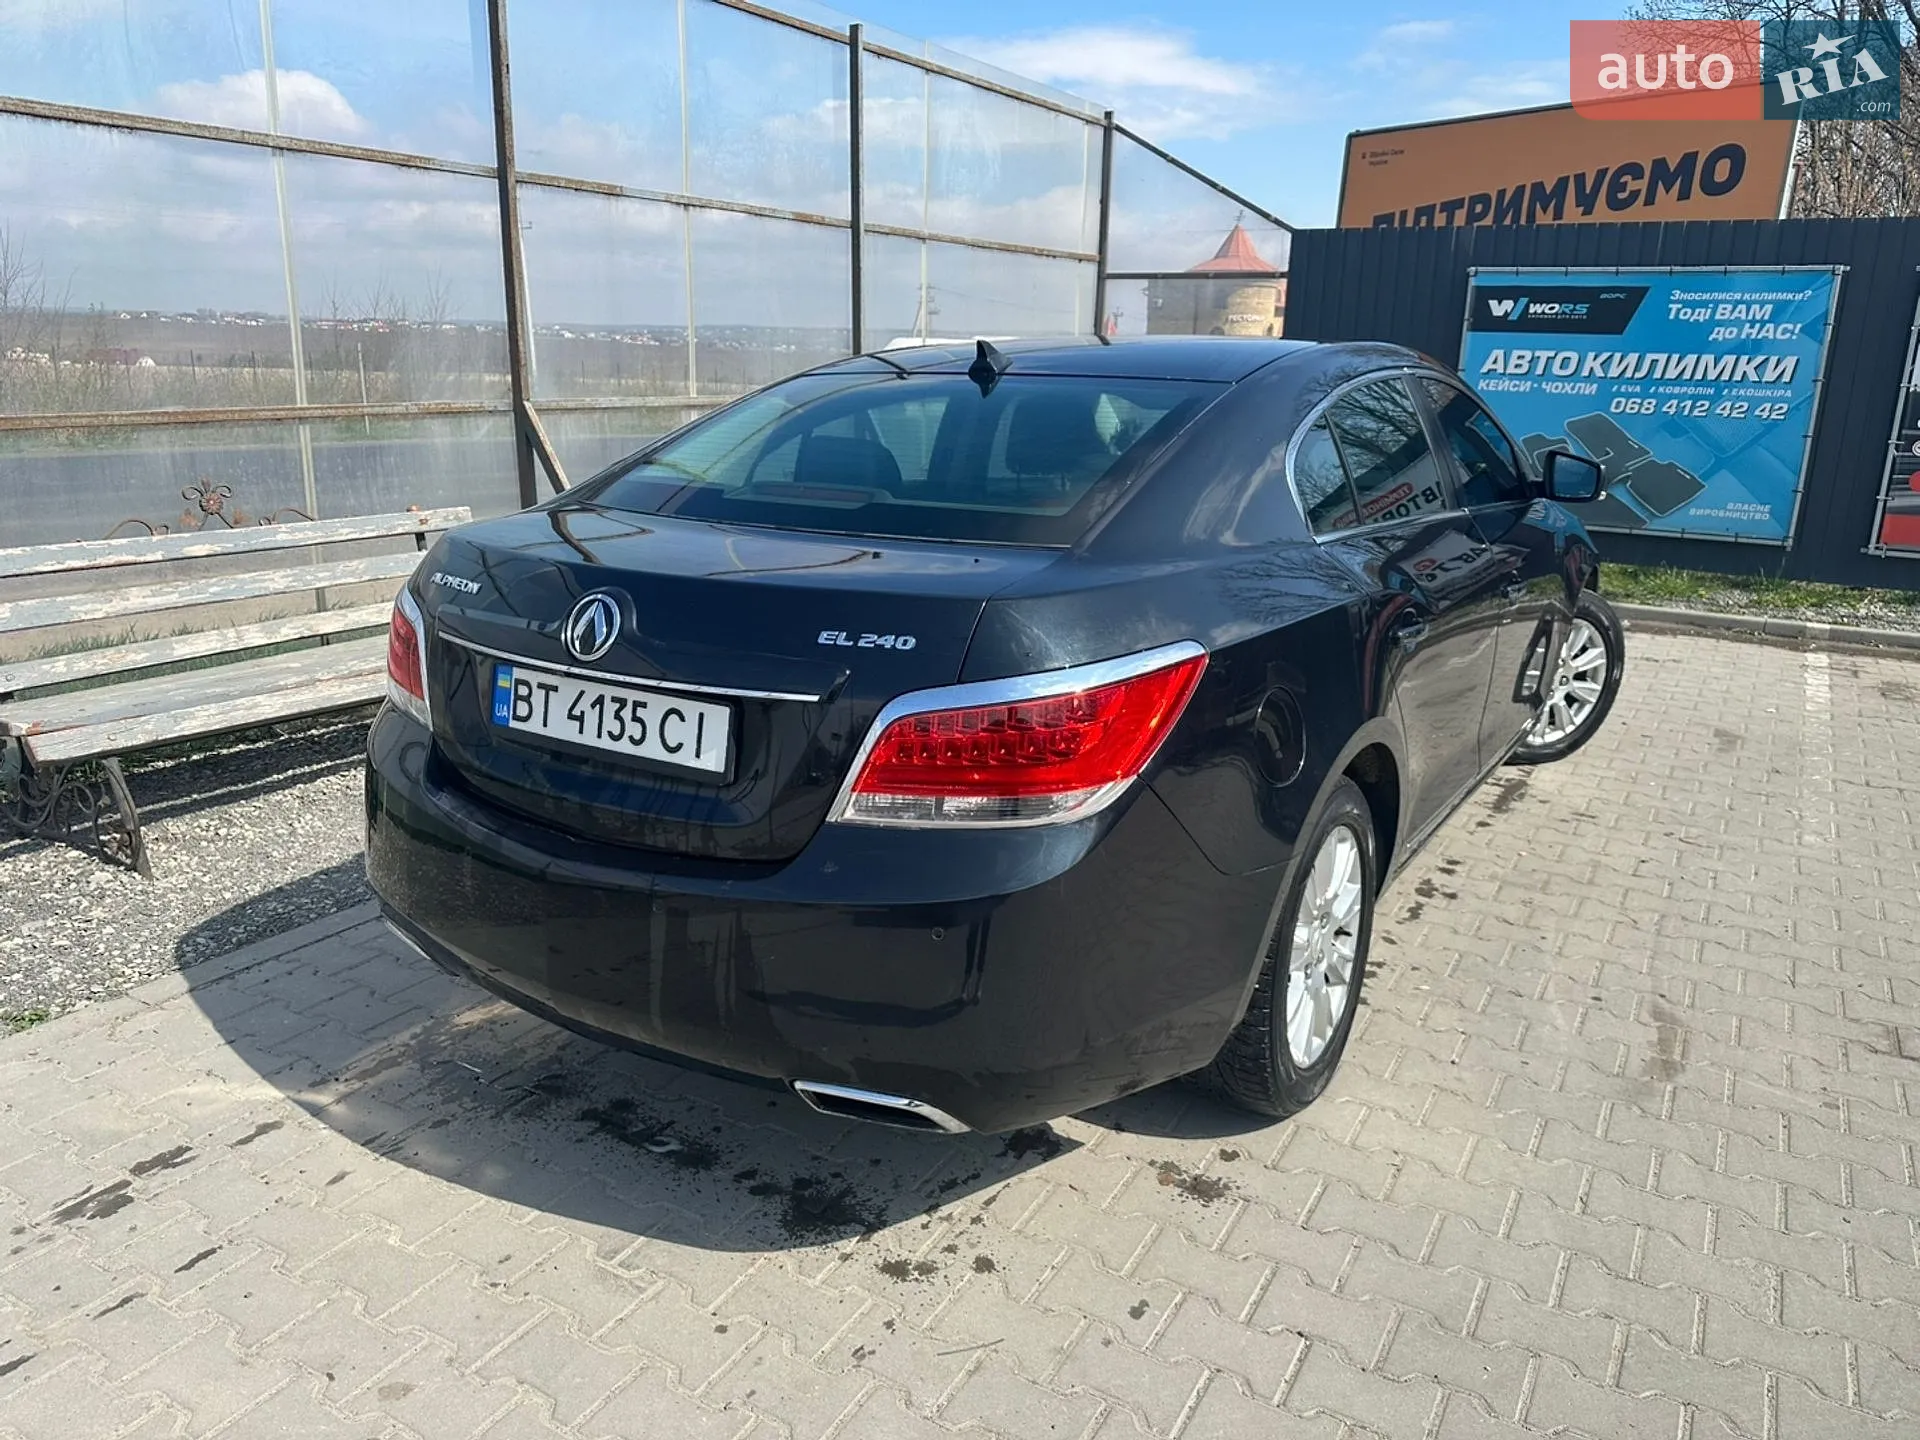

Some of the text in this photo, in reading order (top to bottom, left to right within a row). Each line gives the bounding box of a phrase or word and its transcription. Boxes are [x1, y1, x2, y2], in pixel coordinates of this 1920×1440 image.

[1670, 289, 1812, 302] Зносилися килимки?
[1528, 303, 1591, 315] WORS
[1668, 303, 1773, 323] Тоді ВАМ
[1708, 323, 1802, 342] до НАС!
[1478, 377, 1599, 395] КЕЙСИ ЧОХЛИ
[1657, 386, 1715, 396] КОВРОЛІН
[1609, 397, 1789, 421] 068 412 42 42
[817, 630, 917, 650] EL 240
[495, 703, 508, 718] UA
[512, 677, 559, 728] BT
[566, 689, 648, 747] 4135
